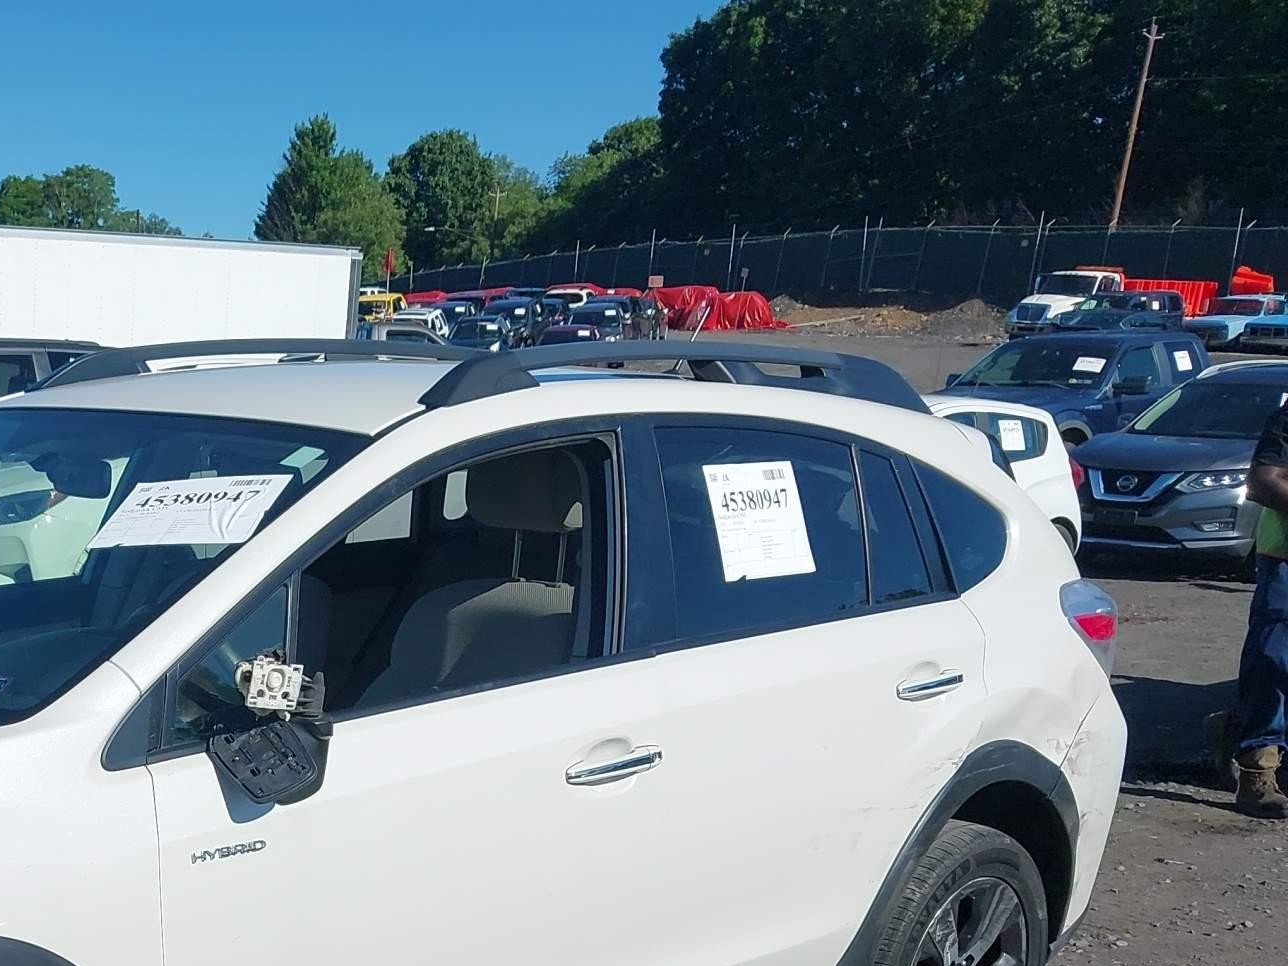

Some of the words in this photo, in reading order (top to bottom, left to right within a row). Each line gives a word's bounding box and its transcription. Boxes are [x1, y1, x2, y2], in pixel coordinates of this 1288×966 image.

[136, 490, 262, 508] 45380947
[721, 488, 788, 512] 45380947
[190, 840, 267, 865] HYBRID
